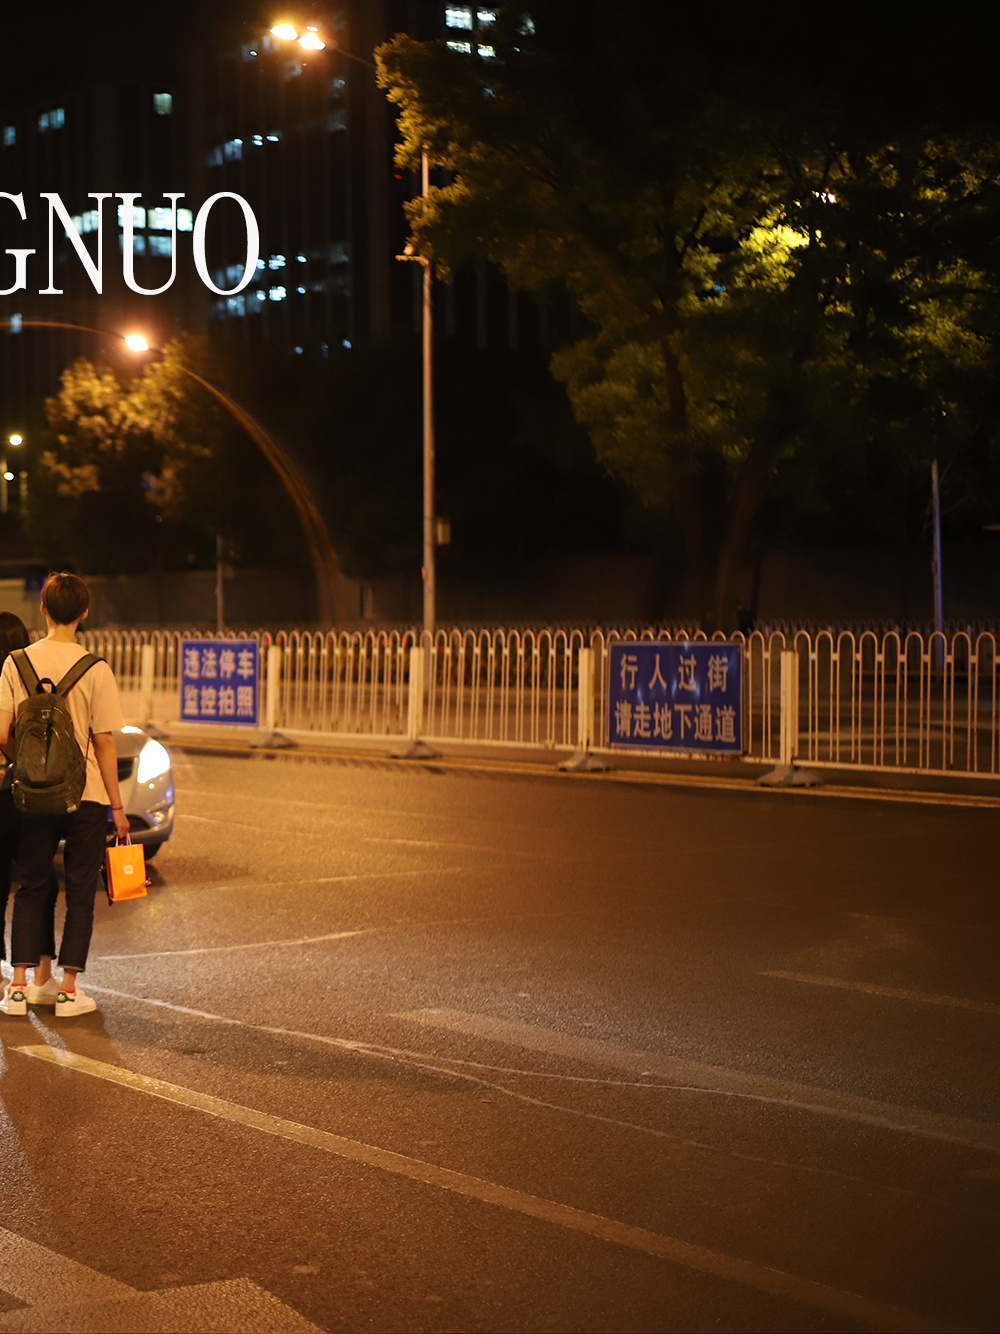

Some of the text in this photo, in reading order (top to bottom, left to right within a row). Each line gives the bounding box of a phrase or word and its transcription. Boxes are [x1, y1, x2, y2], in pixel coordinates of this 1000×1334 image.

[184, 648, 254, 680] 违法停车
[620, 653, 728, 692] 行人过街
[184, 684, 254, 716] 监控拍照
[614, 700, 736, 743] 请走地下通道
